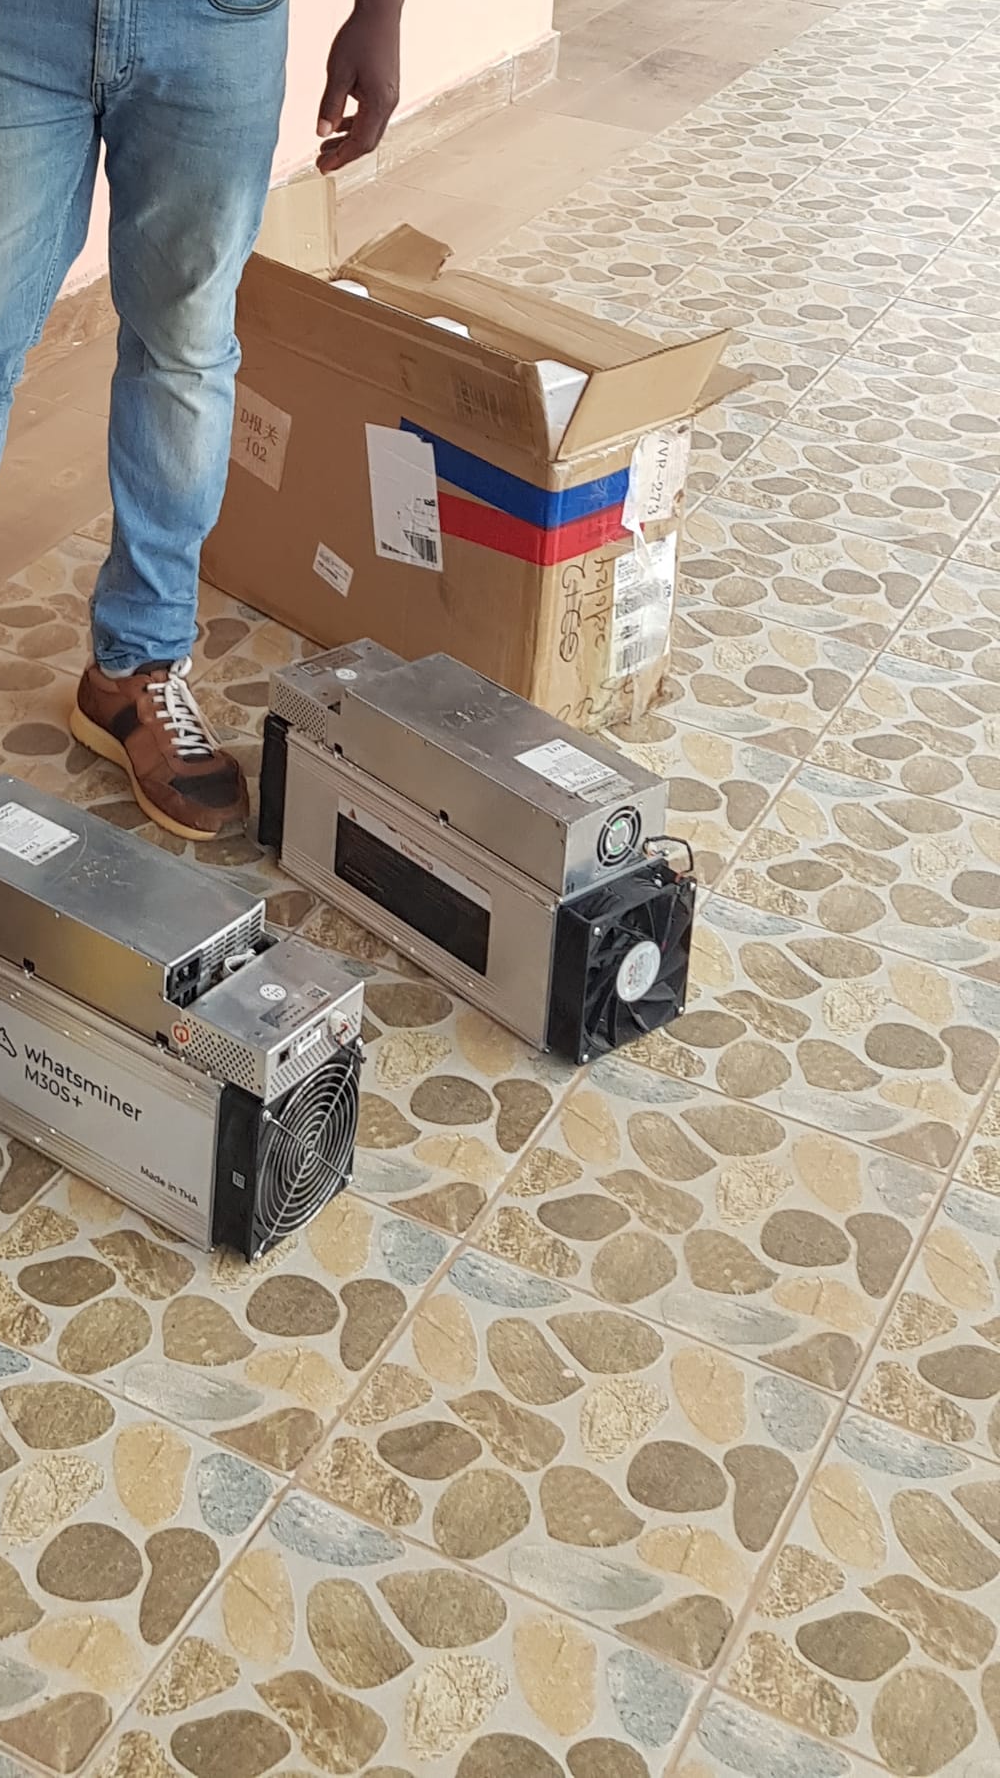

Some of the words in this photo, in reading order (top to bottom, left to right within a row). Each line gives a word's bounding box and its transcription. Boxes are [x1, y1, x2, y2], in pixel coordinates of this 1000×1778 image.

[244, 436, 268, 463] 102
[23, 1043, 143, 1122] whatsminer
[24, 1064, 84, 1108] M30S+
[140, 1165, 167, 1188] Made
[167, 1179, 178, 1195] in
